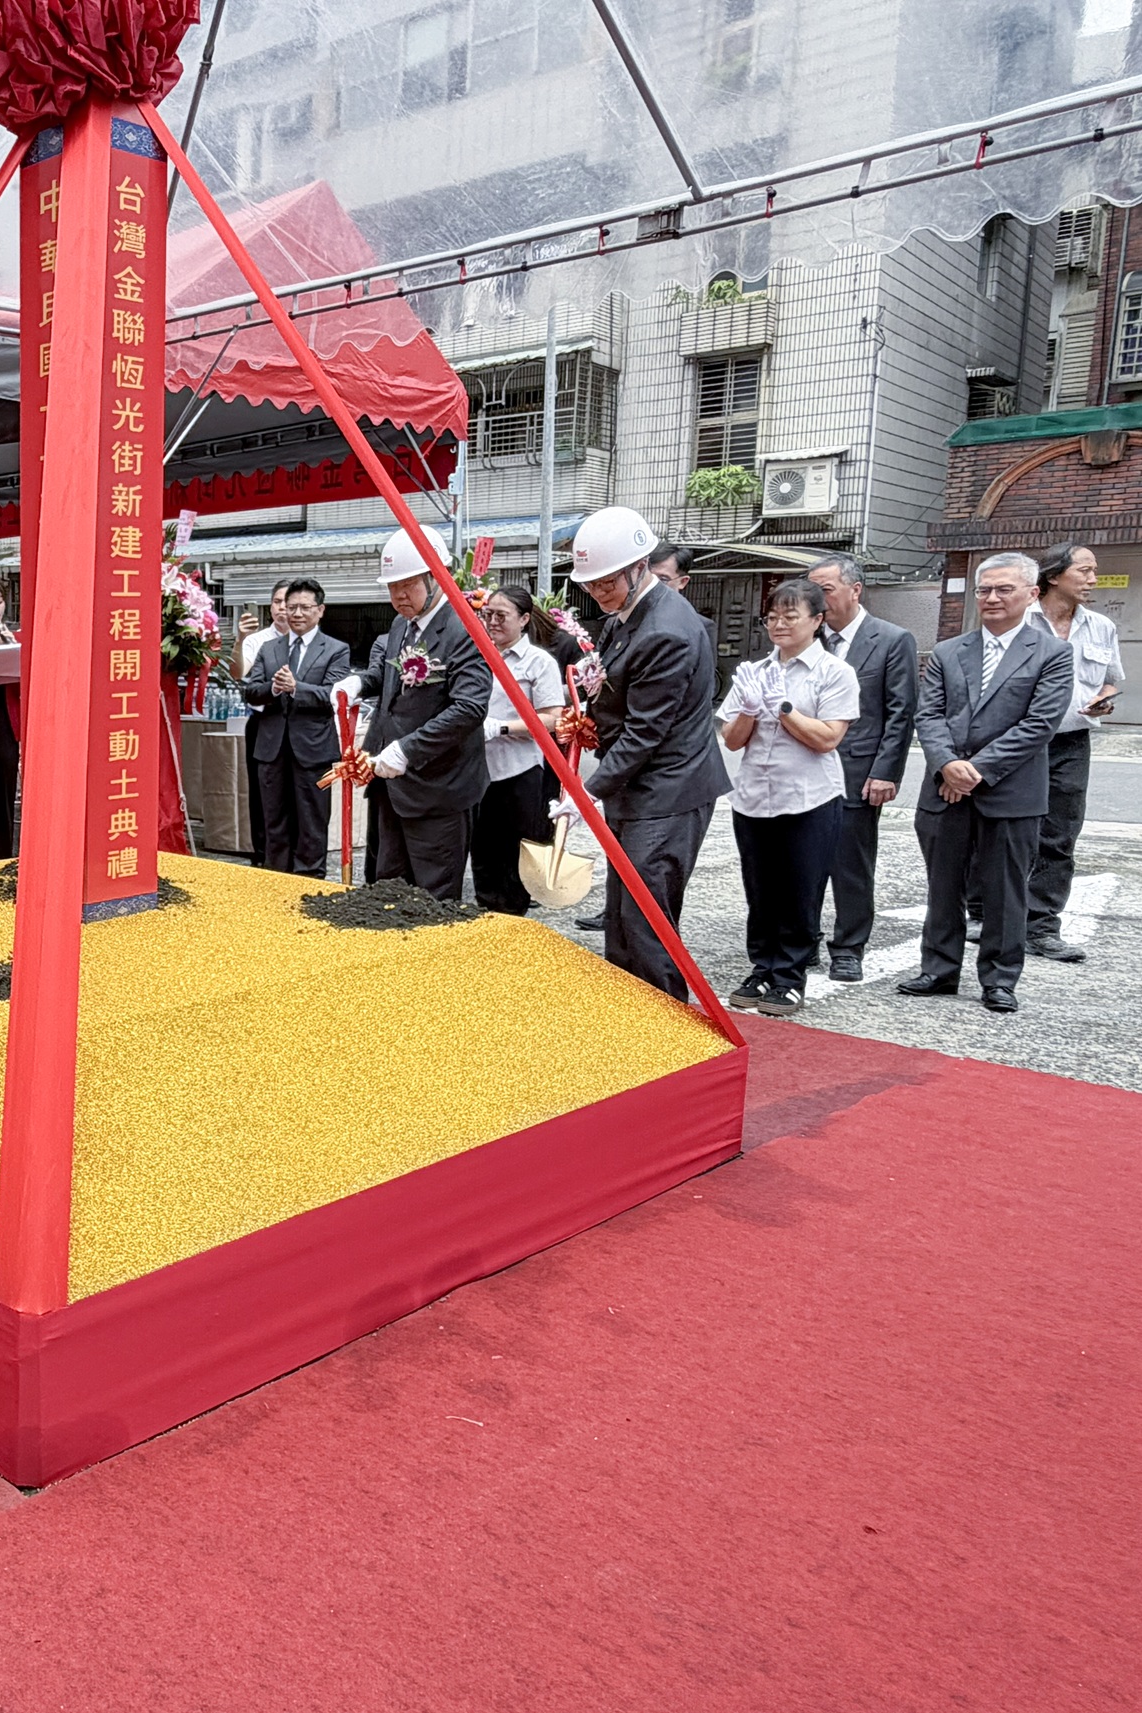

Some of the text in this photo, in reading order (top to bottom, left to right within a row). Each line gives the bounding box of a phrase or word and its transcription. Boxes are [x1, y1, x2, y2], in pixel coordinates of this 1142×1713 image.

[107, 175, 146, 880] 台灣金聯恆光街新建工程開工動土典禮
